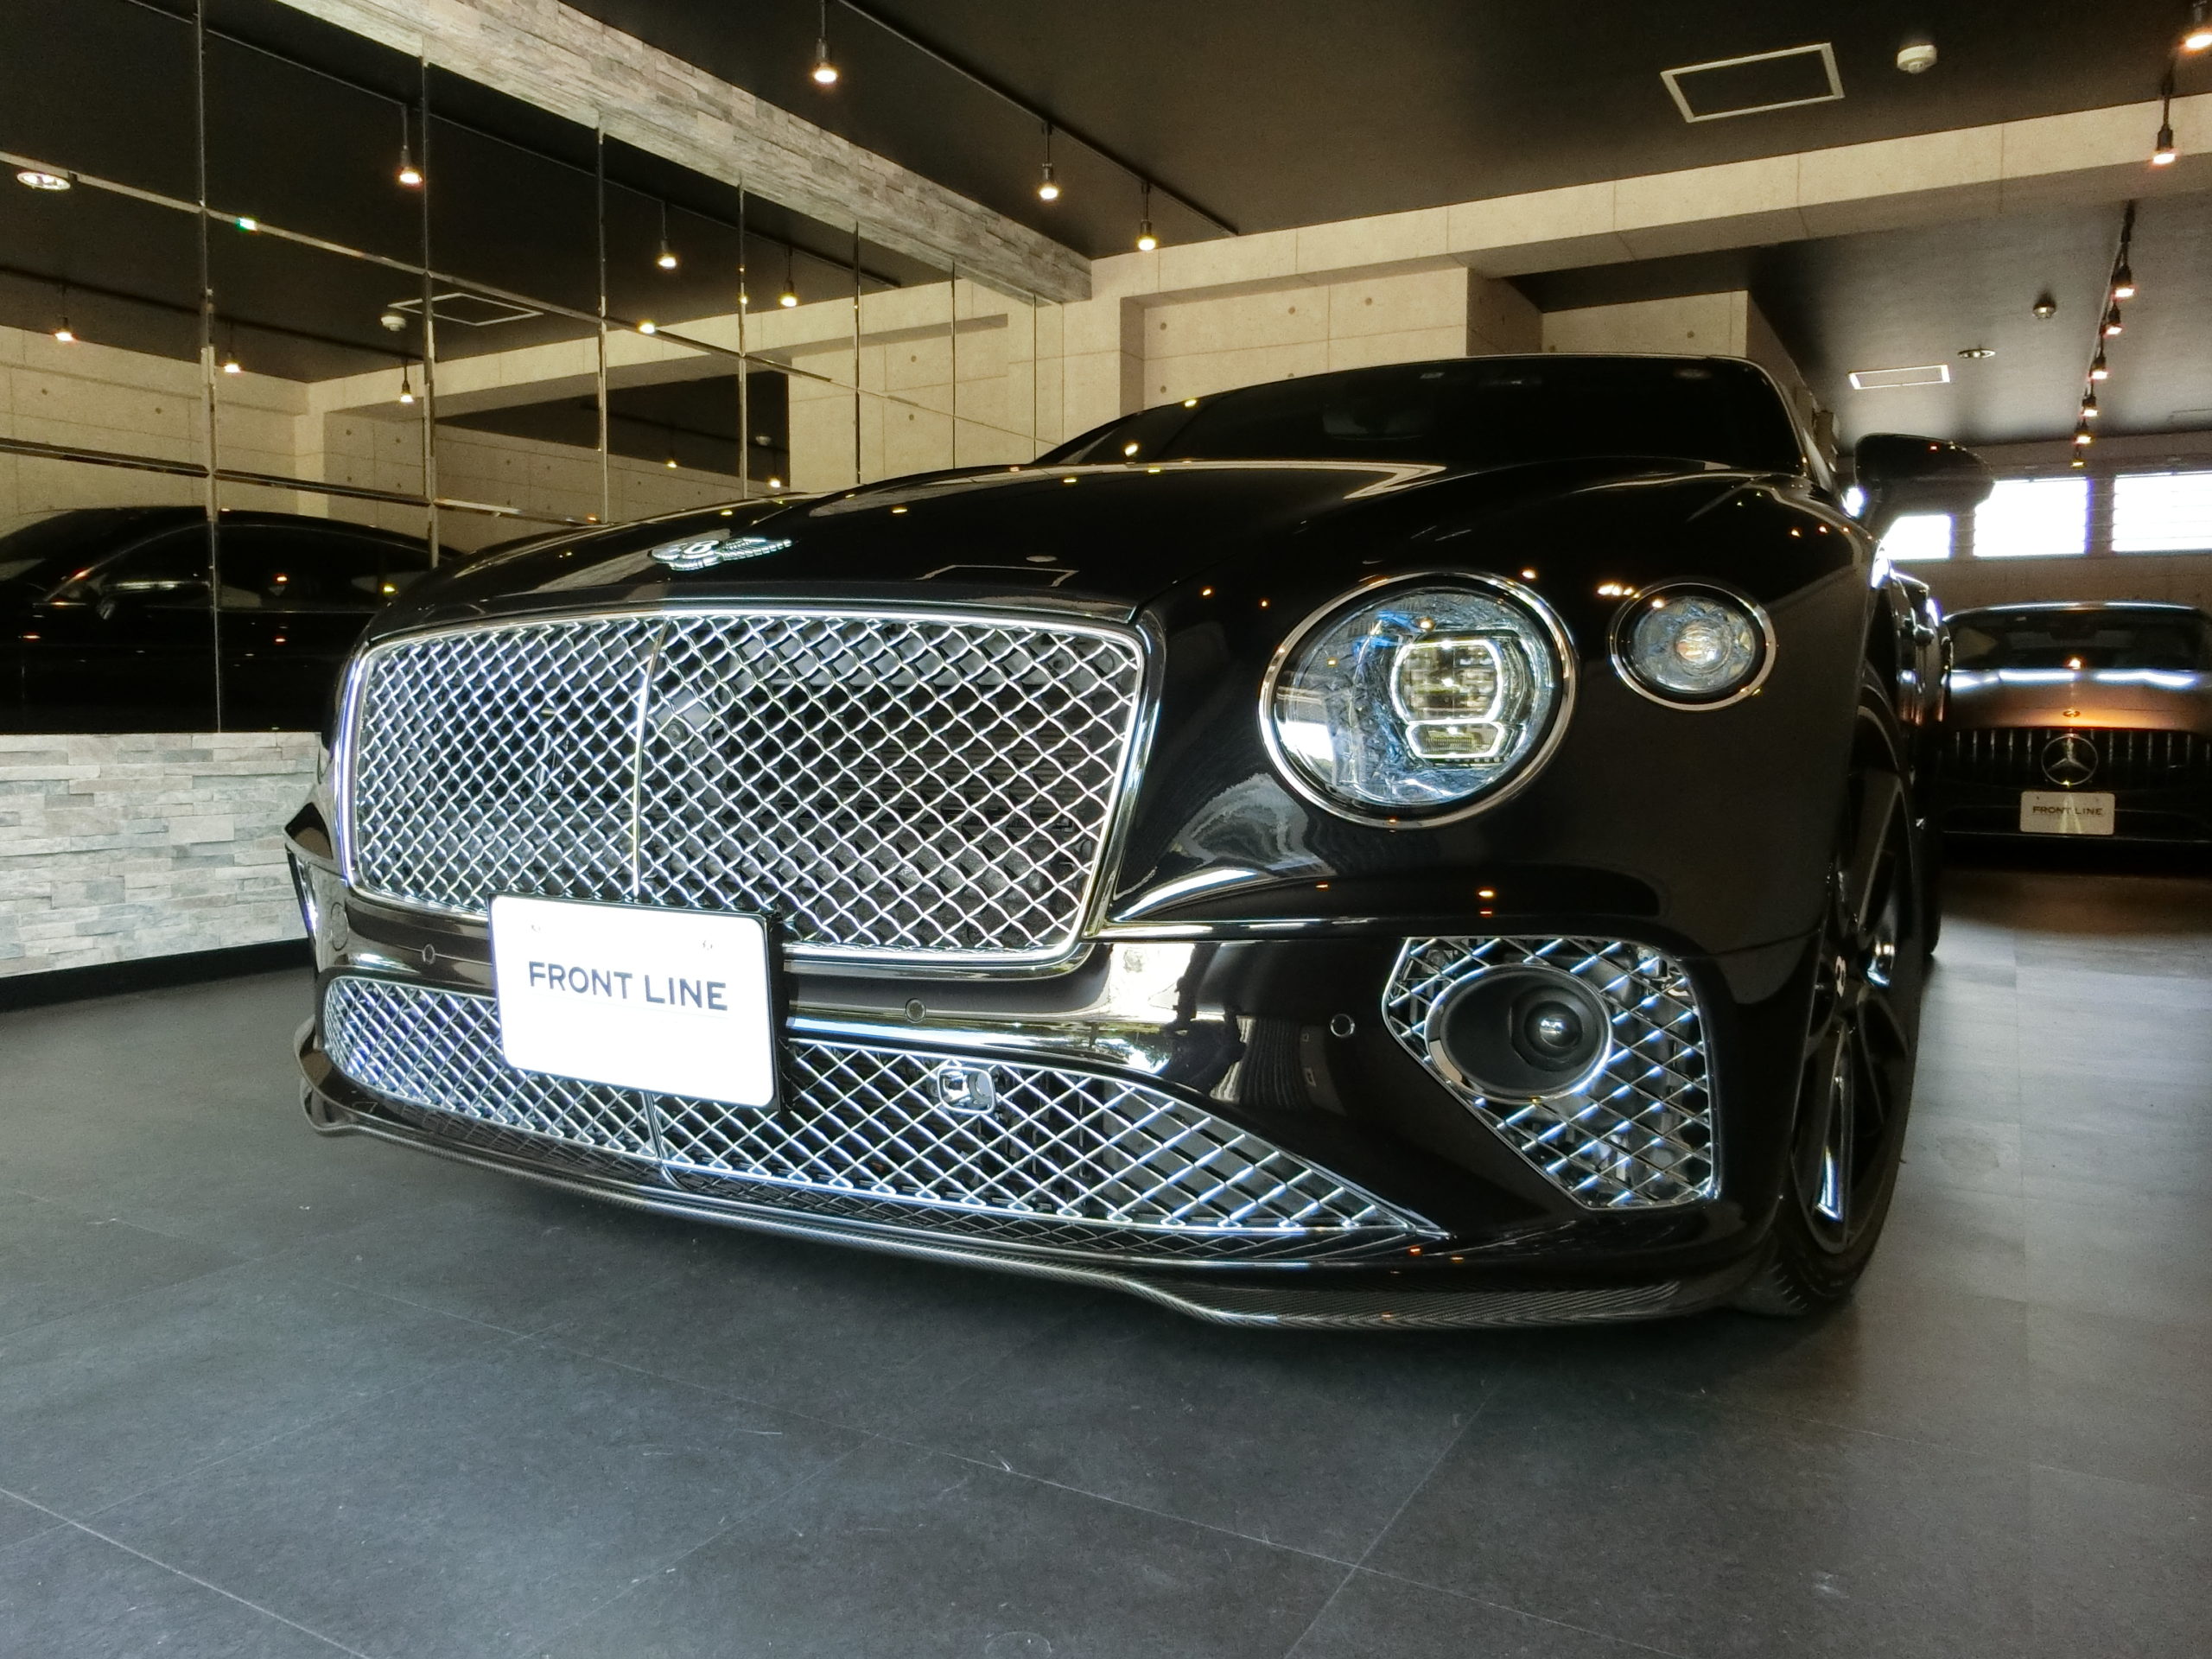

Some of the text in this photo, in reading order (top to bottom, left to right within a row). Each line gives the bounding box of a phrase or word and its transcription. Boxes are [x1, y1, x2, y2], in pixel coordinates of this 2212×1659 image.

[2032, 805, 2103, 816] FRONT LINE
[528, 960, 728, 1012] FRONT LINE
